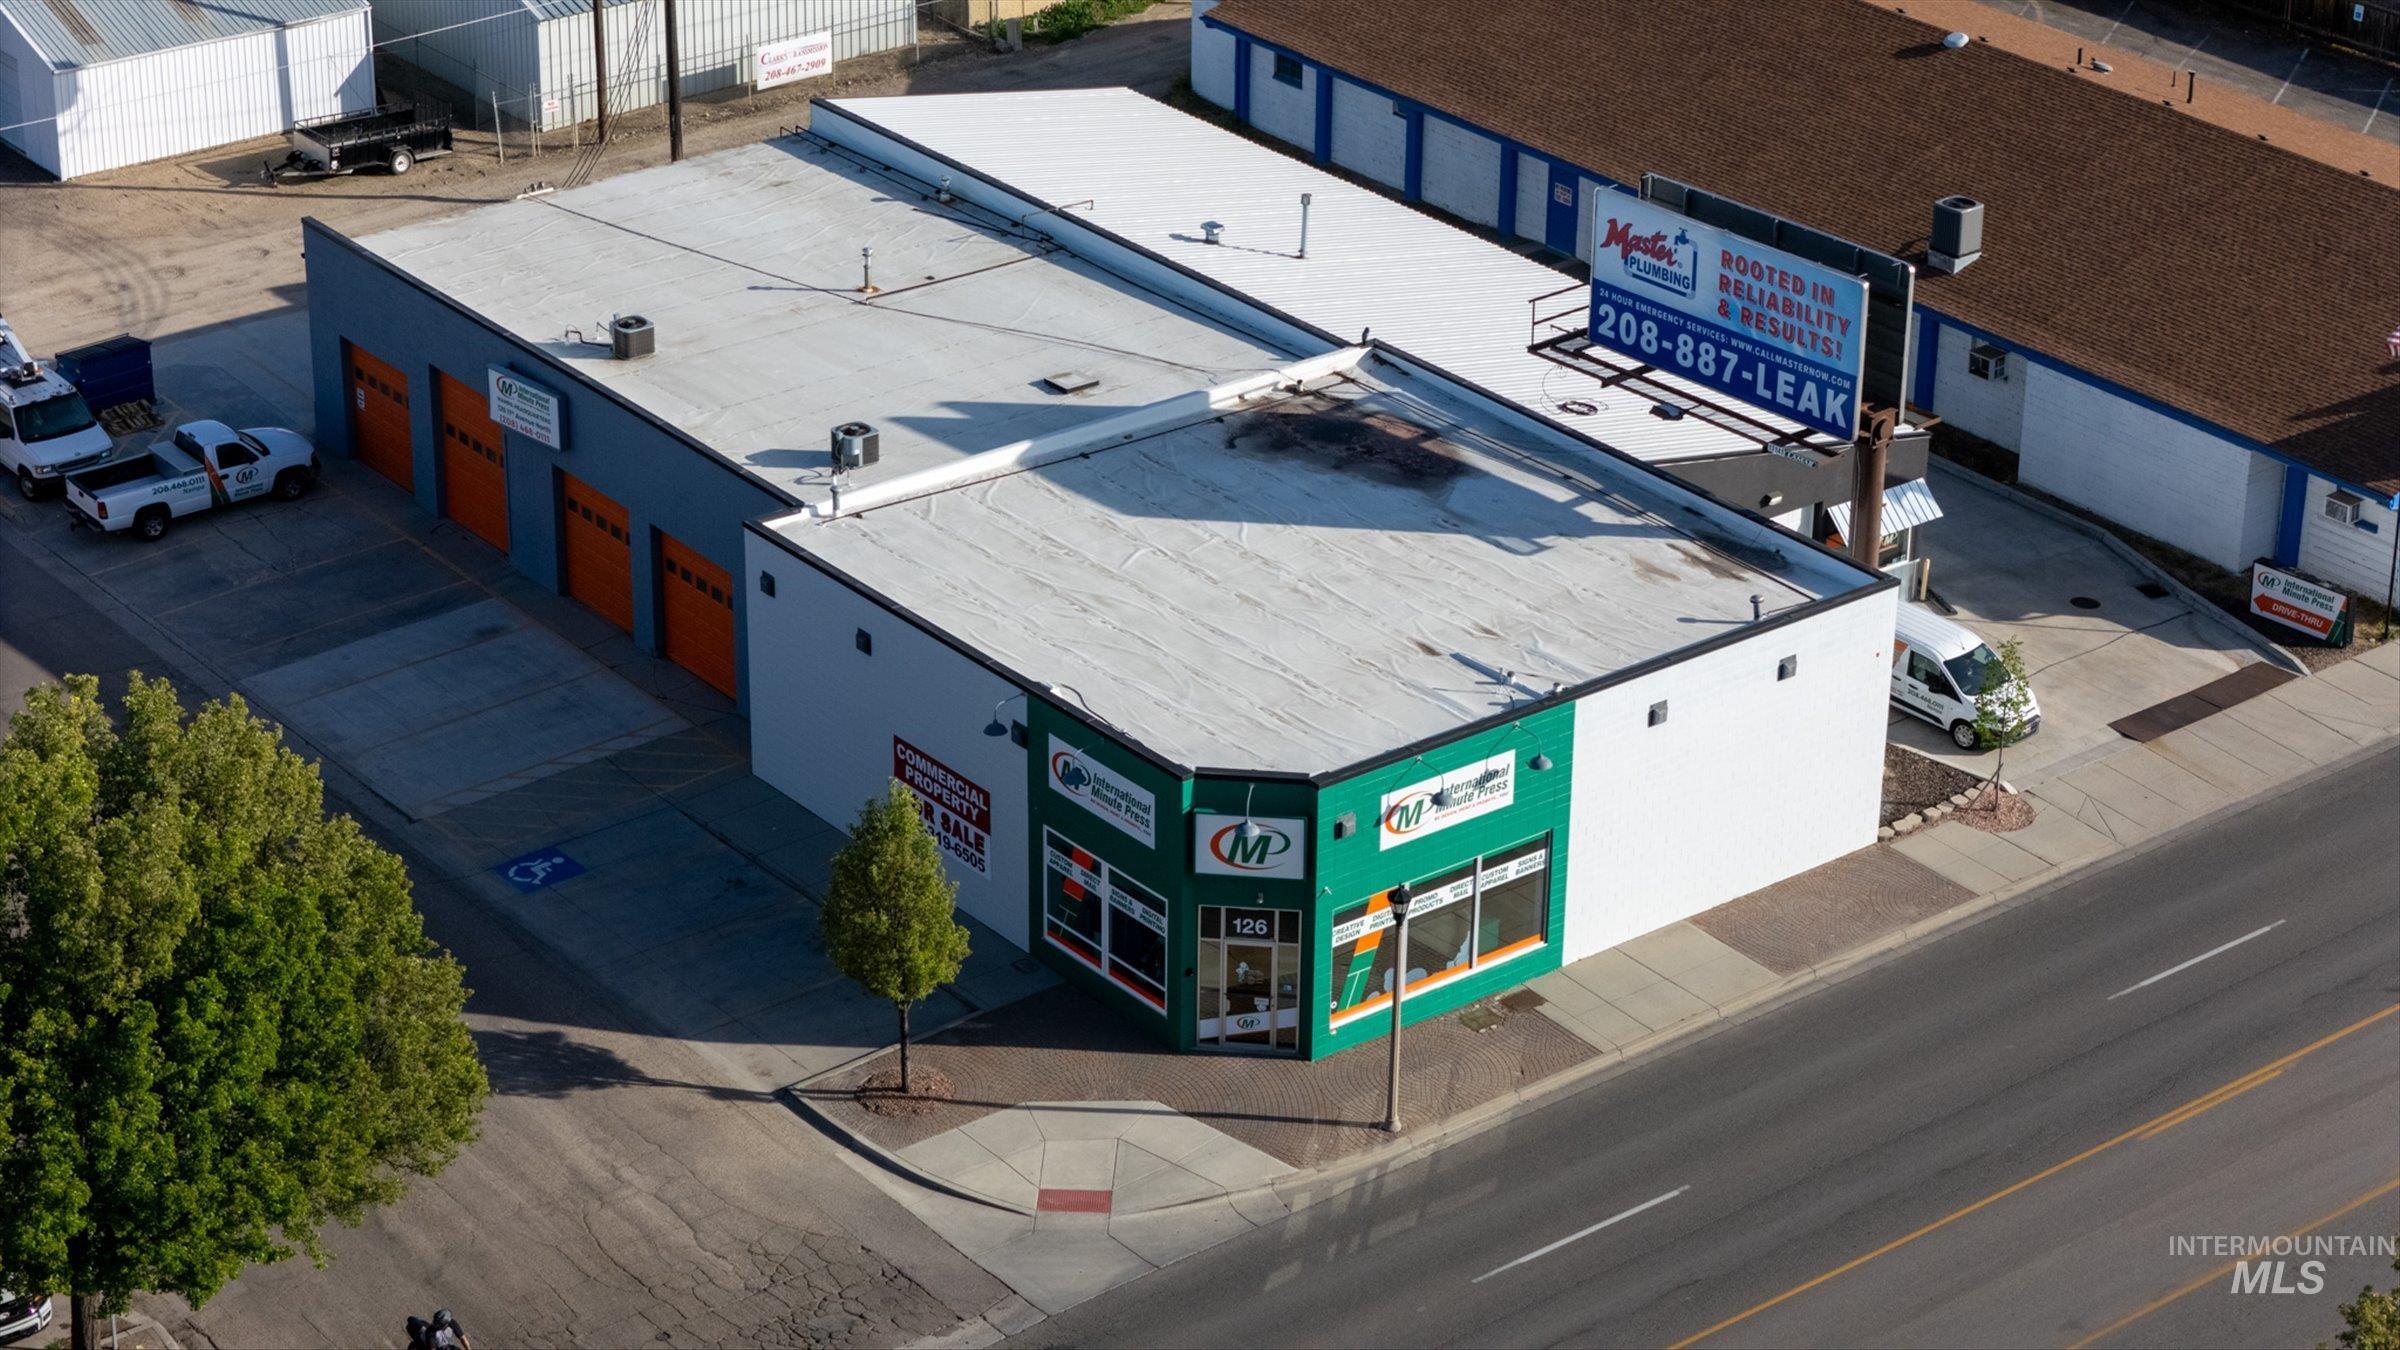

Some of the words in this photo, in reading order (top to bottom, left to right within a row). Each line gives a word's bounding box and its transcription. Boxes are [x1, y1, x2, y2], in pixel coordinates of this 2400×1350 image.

[765, 58, 827, 81] 208-467-2909
[1600, 218, 1677, 267] Master
[1629, 256, 1690, 289] PLUMBING
[1721, 249, 1805, 296] ROOTED
[1811, 282, 1834, 308] IN
[1719, 273, 1851, 337] RELIABILITY
[1600, 288, 1609, 298] 24
[1611, 293, 1633, 307] HOUR
[1635, 303, 1684, 326] EMERGENCY
[1686, 321, 1728, 344] SERVICES:
[1730, 337, 1850, 389] WWW.CALLMASTERNOW.COM
[1718, 299, 1731, 320] &
[1741, 306, 1843, 361] RESULTS!
[1598, 303, 1848, 428] 208-887-LEAK
[2282, 587, 2309, 603] Minute
[2311, 598, 2333, 612] Press
[2284, 579, 2335, 603] International
[2272, 603, 2323, 627] DRIVE-THRU
[896, 743, 988, 811] COMMERCIAL
[1443, 763, 1510, 796] nternational
[1477, 779, 1508, 799] Press
[905, 766, 978, 820] PROPERTY
[1093, 772, 1151, 816] International
[1091, 784, 1123, 812] Minute
[1124, 805, 1151, 829] Press
[941, 811, 985, 856] SALE
[1481, 865, 1508, 881] CUSTOM
[1515, 860, 1545, 876] BANNERS
[1518, 855, 1537, 867] SIGNS
[1450, 879, 1473, 893] DIRECT
[1480, 873, 1508, 888] APPAREL
[1414, 892, 1438, 907] PROMO
[1453, 889, 1468, 898] MAIL
[1408, 898, 1444, 915] PRODUCTS
[1233, 918, 1268, 935] 126
[1335, 930, 1361, 943] DESIGN
